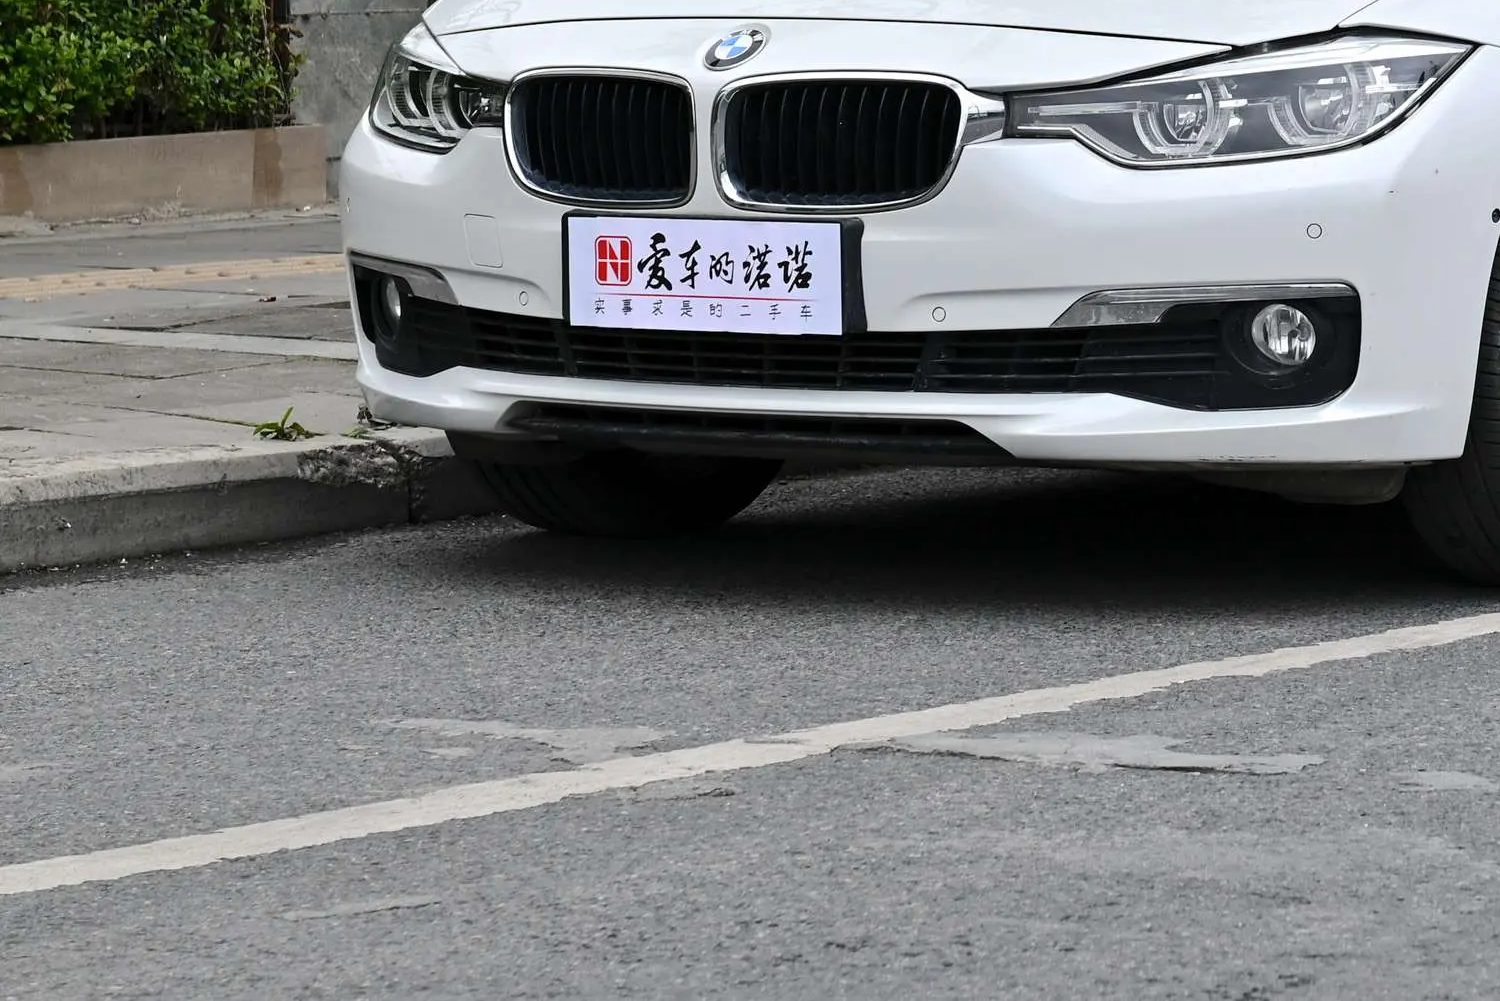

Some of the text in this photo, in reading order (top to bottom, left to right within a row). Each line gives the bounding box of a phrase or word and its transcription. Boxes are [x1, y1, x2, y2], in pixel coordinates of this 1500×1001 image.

[594, 298, 813, 322] 实事求是的二手车
